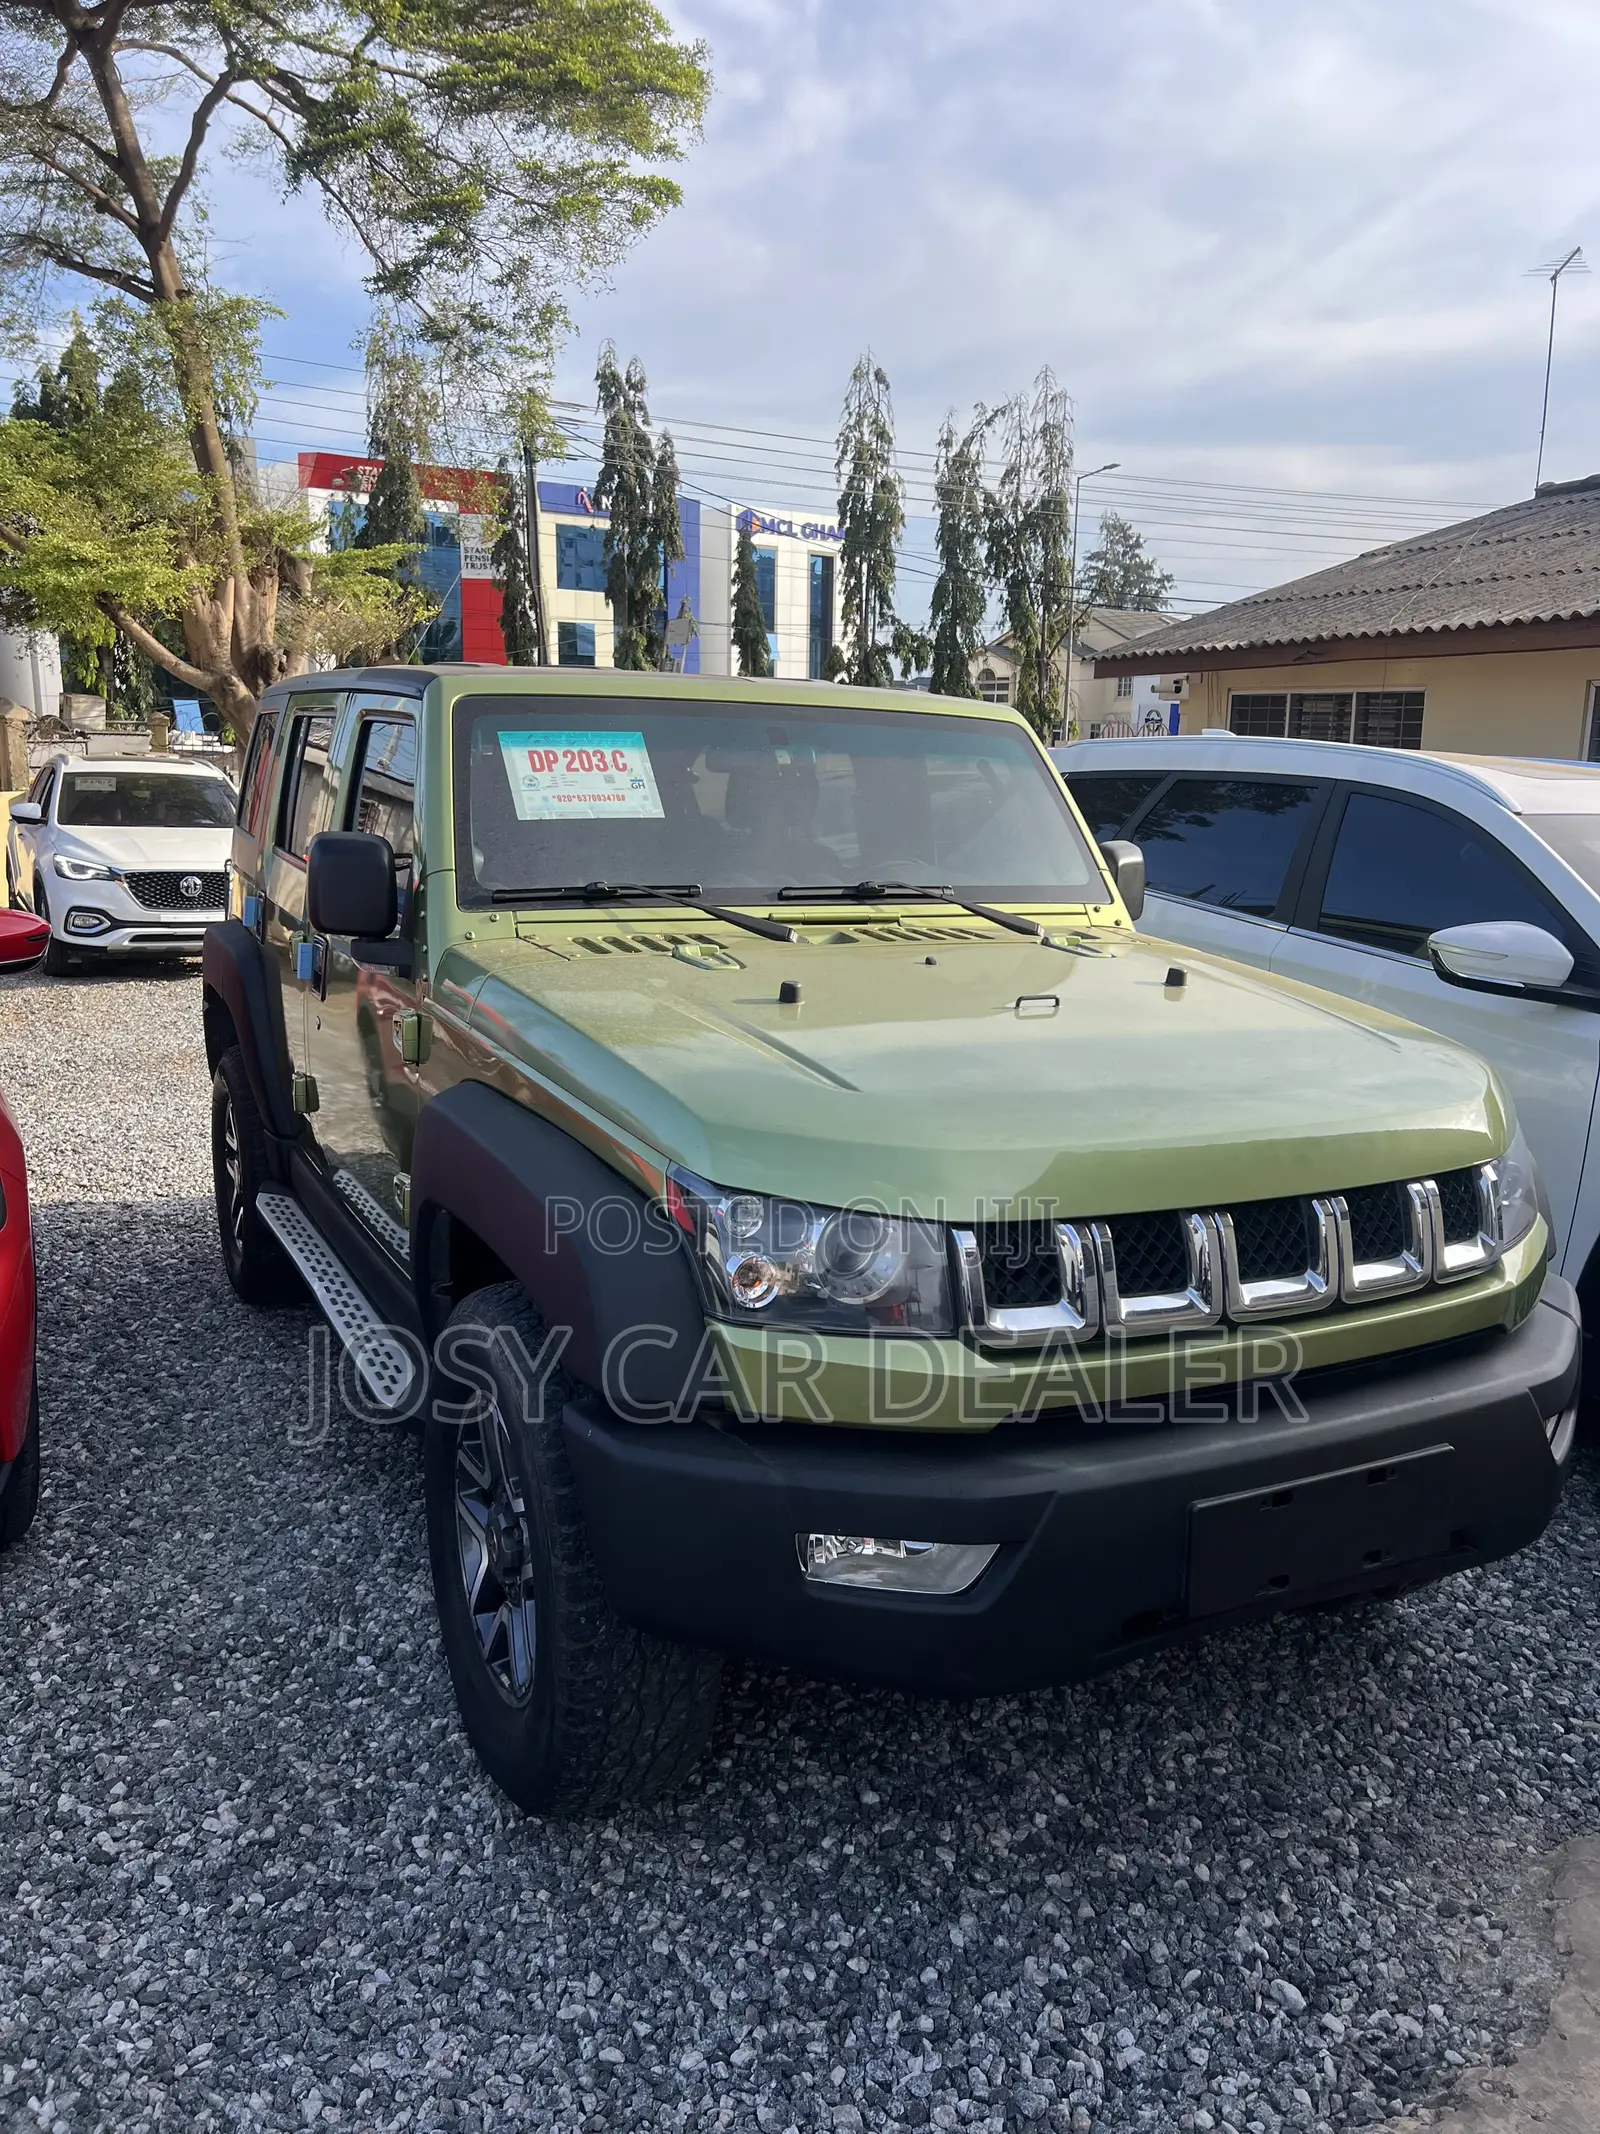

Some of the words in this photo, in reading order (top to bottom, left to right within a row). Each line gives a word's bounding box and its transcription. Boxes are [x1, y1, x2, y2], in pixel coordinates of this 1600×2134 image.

[357, 465, 382, 476] STA
[760, 517, 797, 537] MCL
[528, 749, 559, 773] DP
[562, 749, 609, 773] 203
[611, 749, 628, 773] C
[631, 782, 646, 790] GH
